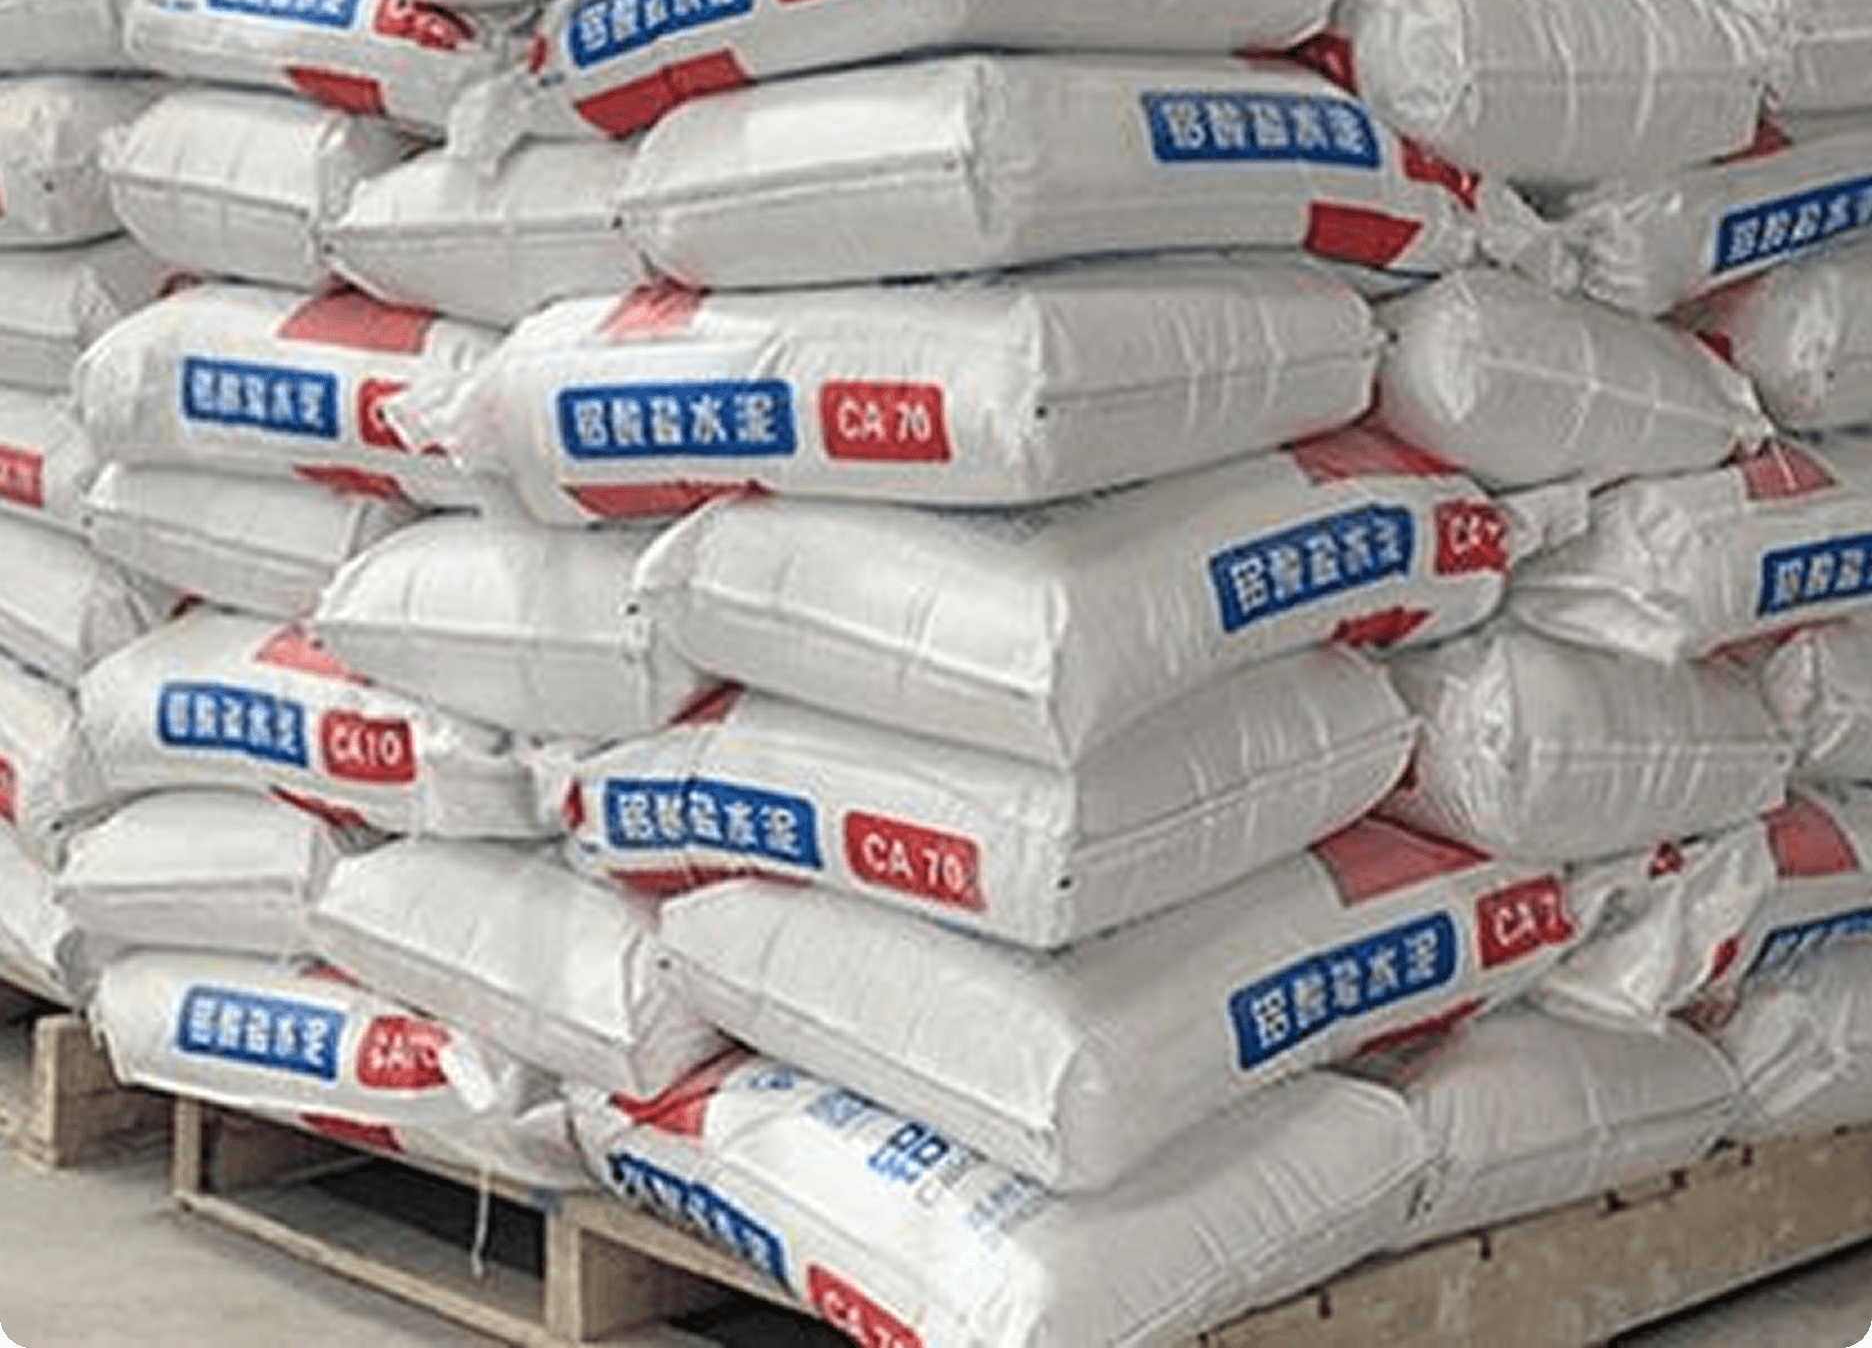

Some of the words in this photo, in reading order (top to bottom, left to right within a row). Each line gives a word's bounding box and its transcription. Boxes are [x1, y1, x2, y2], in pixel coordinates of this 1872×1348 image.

[572, 393, 778, 447] 铝酸盐水泥
[837, 398, 884, 441] CA
[895, 402, 931, 442] 70
[619, 791, 799, 856] 铝酸盐水泥
[860, 832, 914, 880] CA
[922, 848, 963, 893] 70
[1251, 928, 1439, 1050] 铝酸盐水泥
